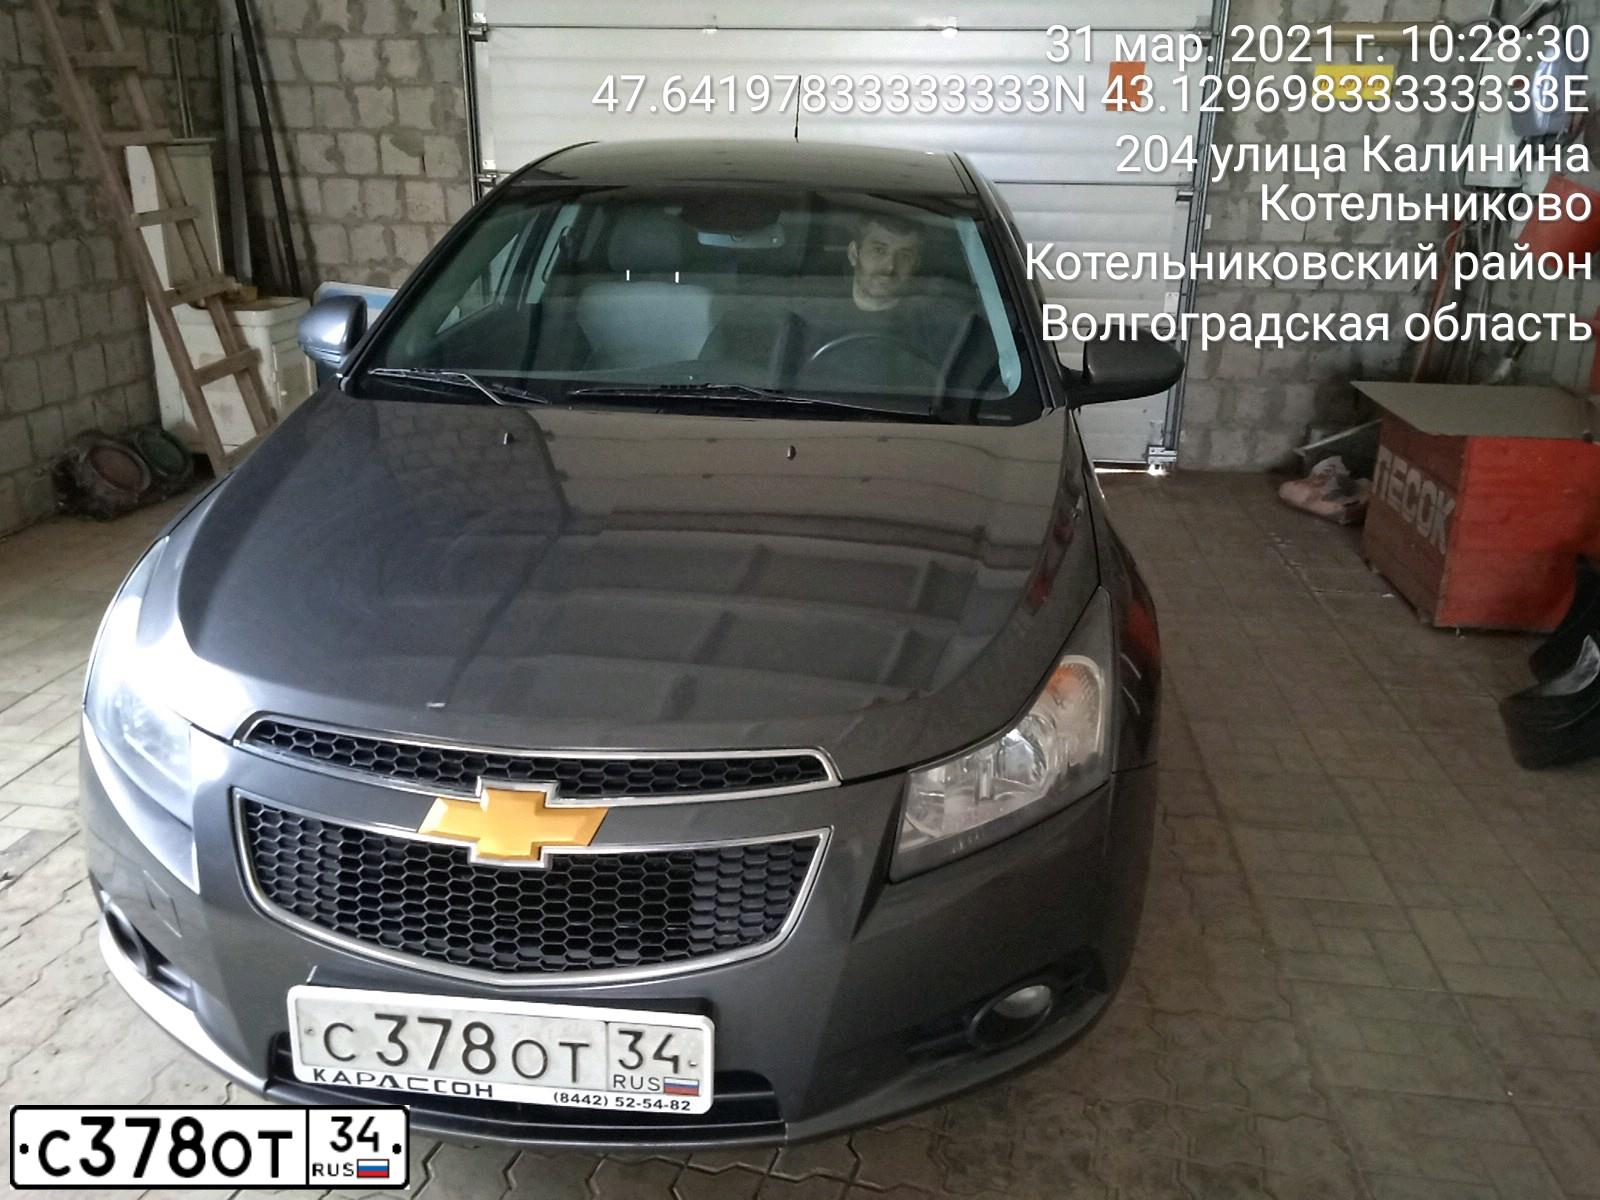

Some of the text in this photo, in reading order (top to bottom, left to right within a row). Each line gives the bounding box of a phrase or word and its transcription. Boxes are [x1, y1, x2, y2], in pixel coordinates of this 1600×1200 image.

[1372, 445, 1457, 555] ПЕСОК
[617, 1030, 680, 1074] 34
[613, 1074, 661, 1092] RUS
[553, 1091, 691, 1112] (8442) 52-54-82
